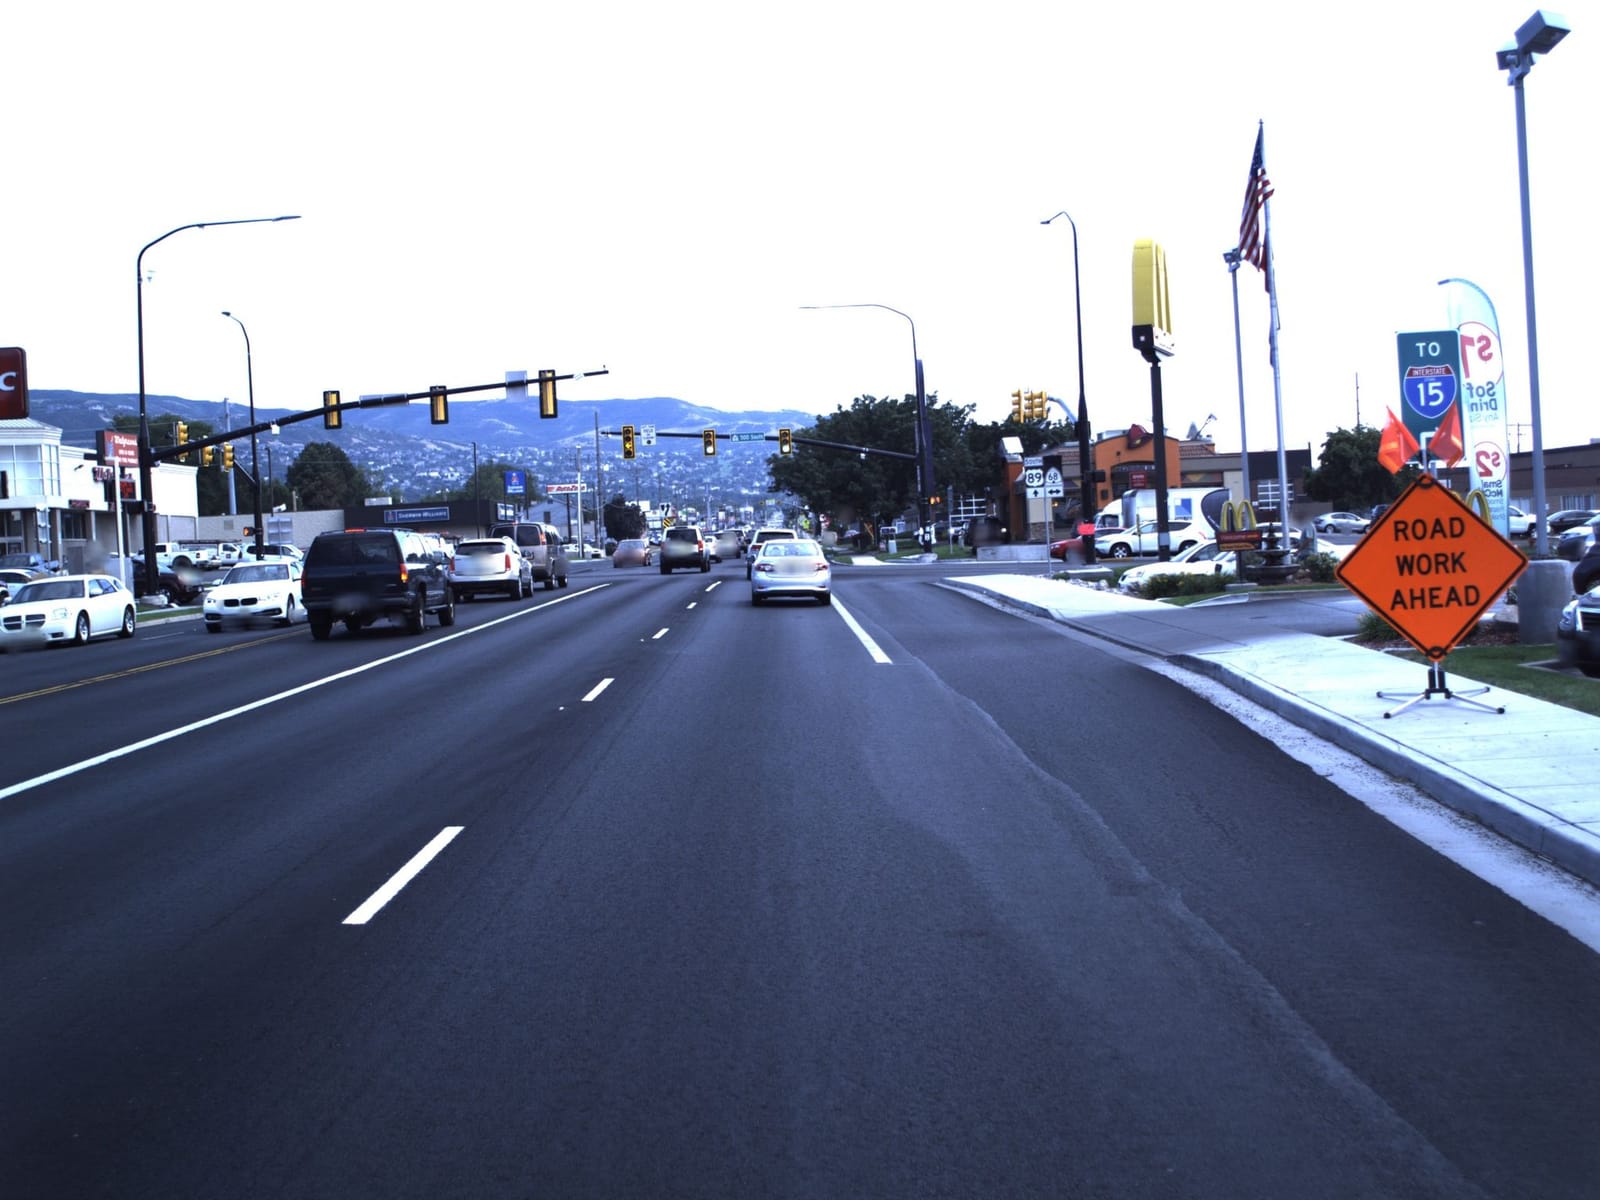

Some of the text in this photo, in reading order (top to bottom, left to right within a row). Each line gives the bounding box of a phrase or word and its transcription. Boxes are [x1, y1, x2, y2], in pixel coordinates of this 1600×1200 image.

[1415, 341, 1440, 357] TO
[1412, 367, 1446, 376] INTERSTATE
[1417, 382, 1444, 406] 15
[1028, 472, 1042, 484] 89
[1048, 472, 1058, 481] 68
[1393, 517, 1465, 541] ROAD
[1396, 552, 1467, 576] WORK
[1390, 585, 1480, 611] AHEAD
